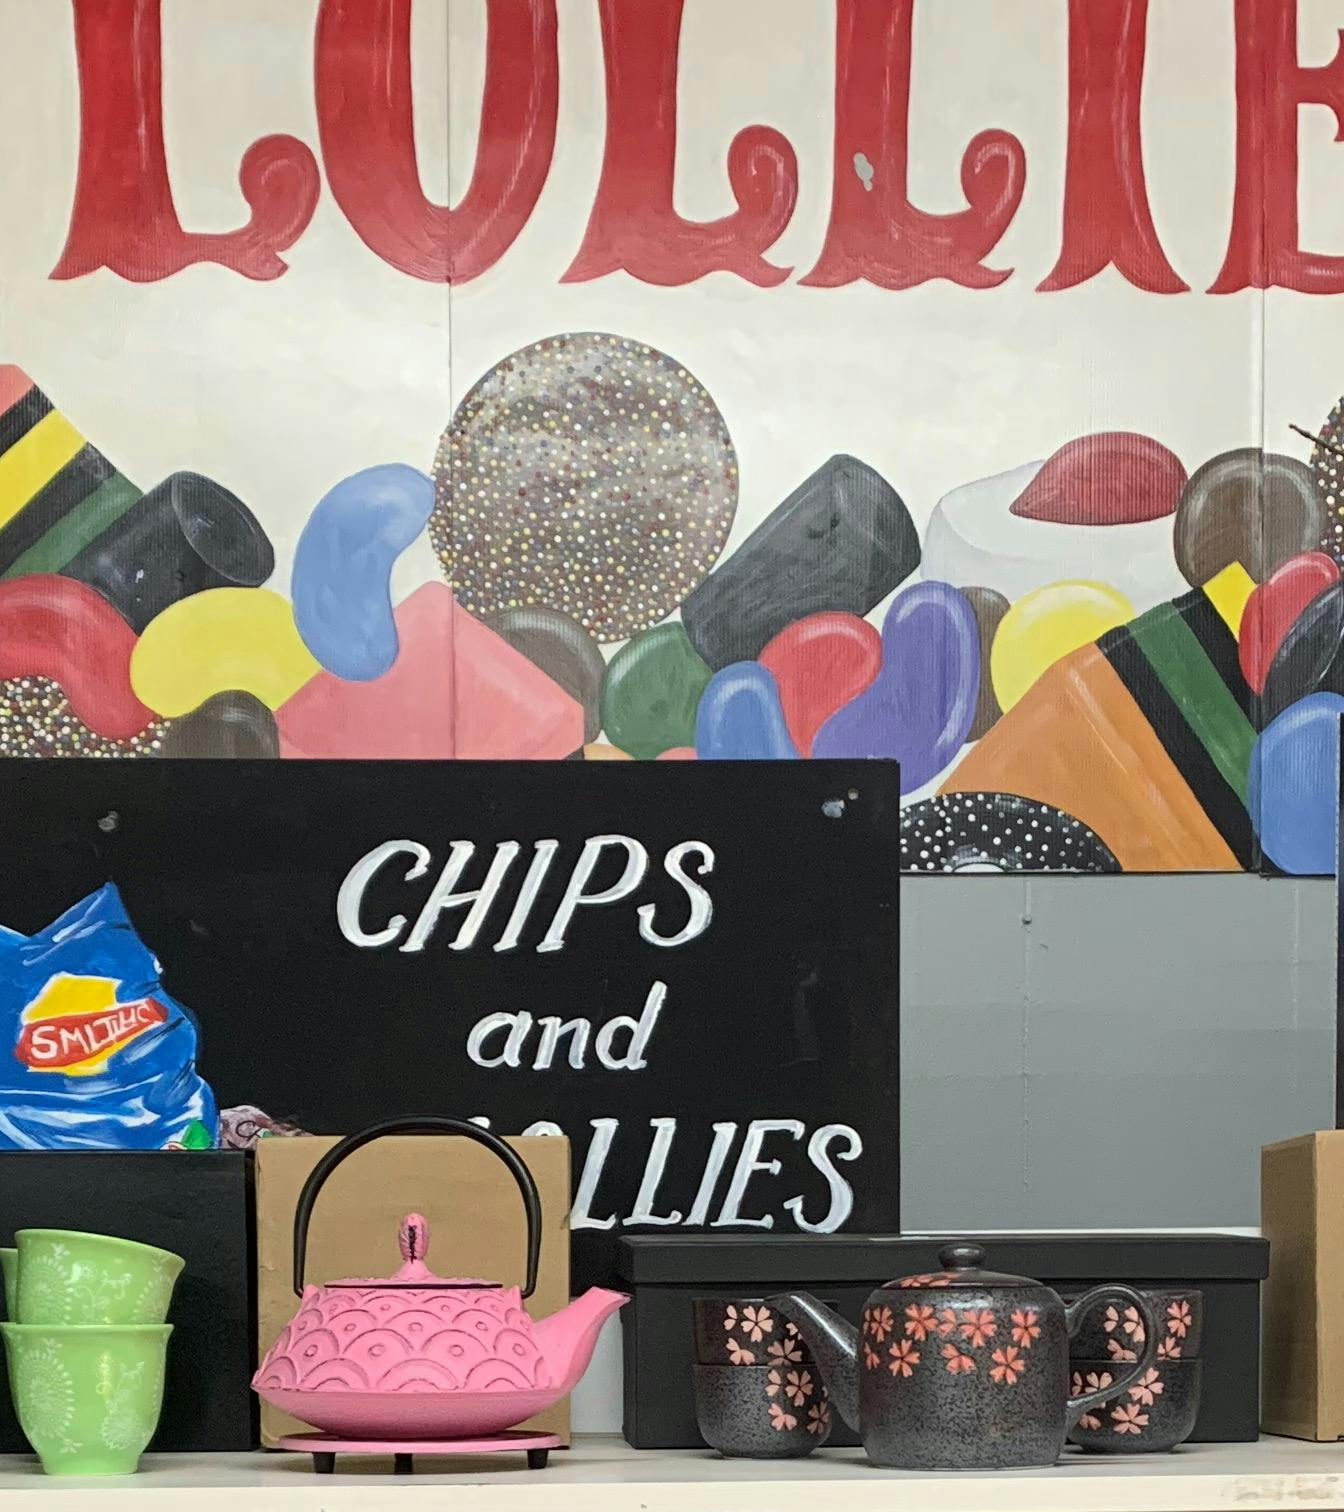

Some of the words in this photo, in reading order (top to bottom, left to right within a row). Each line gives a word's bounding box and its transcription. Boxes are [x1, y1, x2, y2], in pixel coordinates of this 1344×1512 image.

[336, 834, 714, 955] CHIPS
[466, 980, 668, 1072] and
[466, 1116, 864, 1234] LLIES
